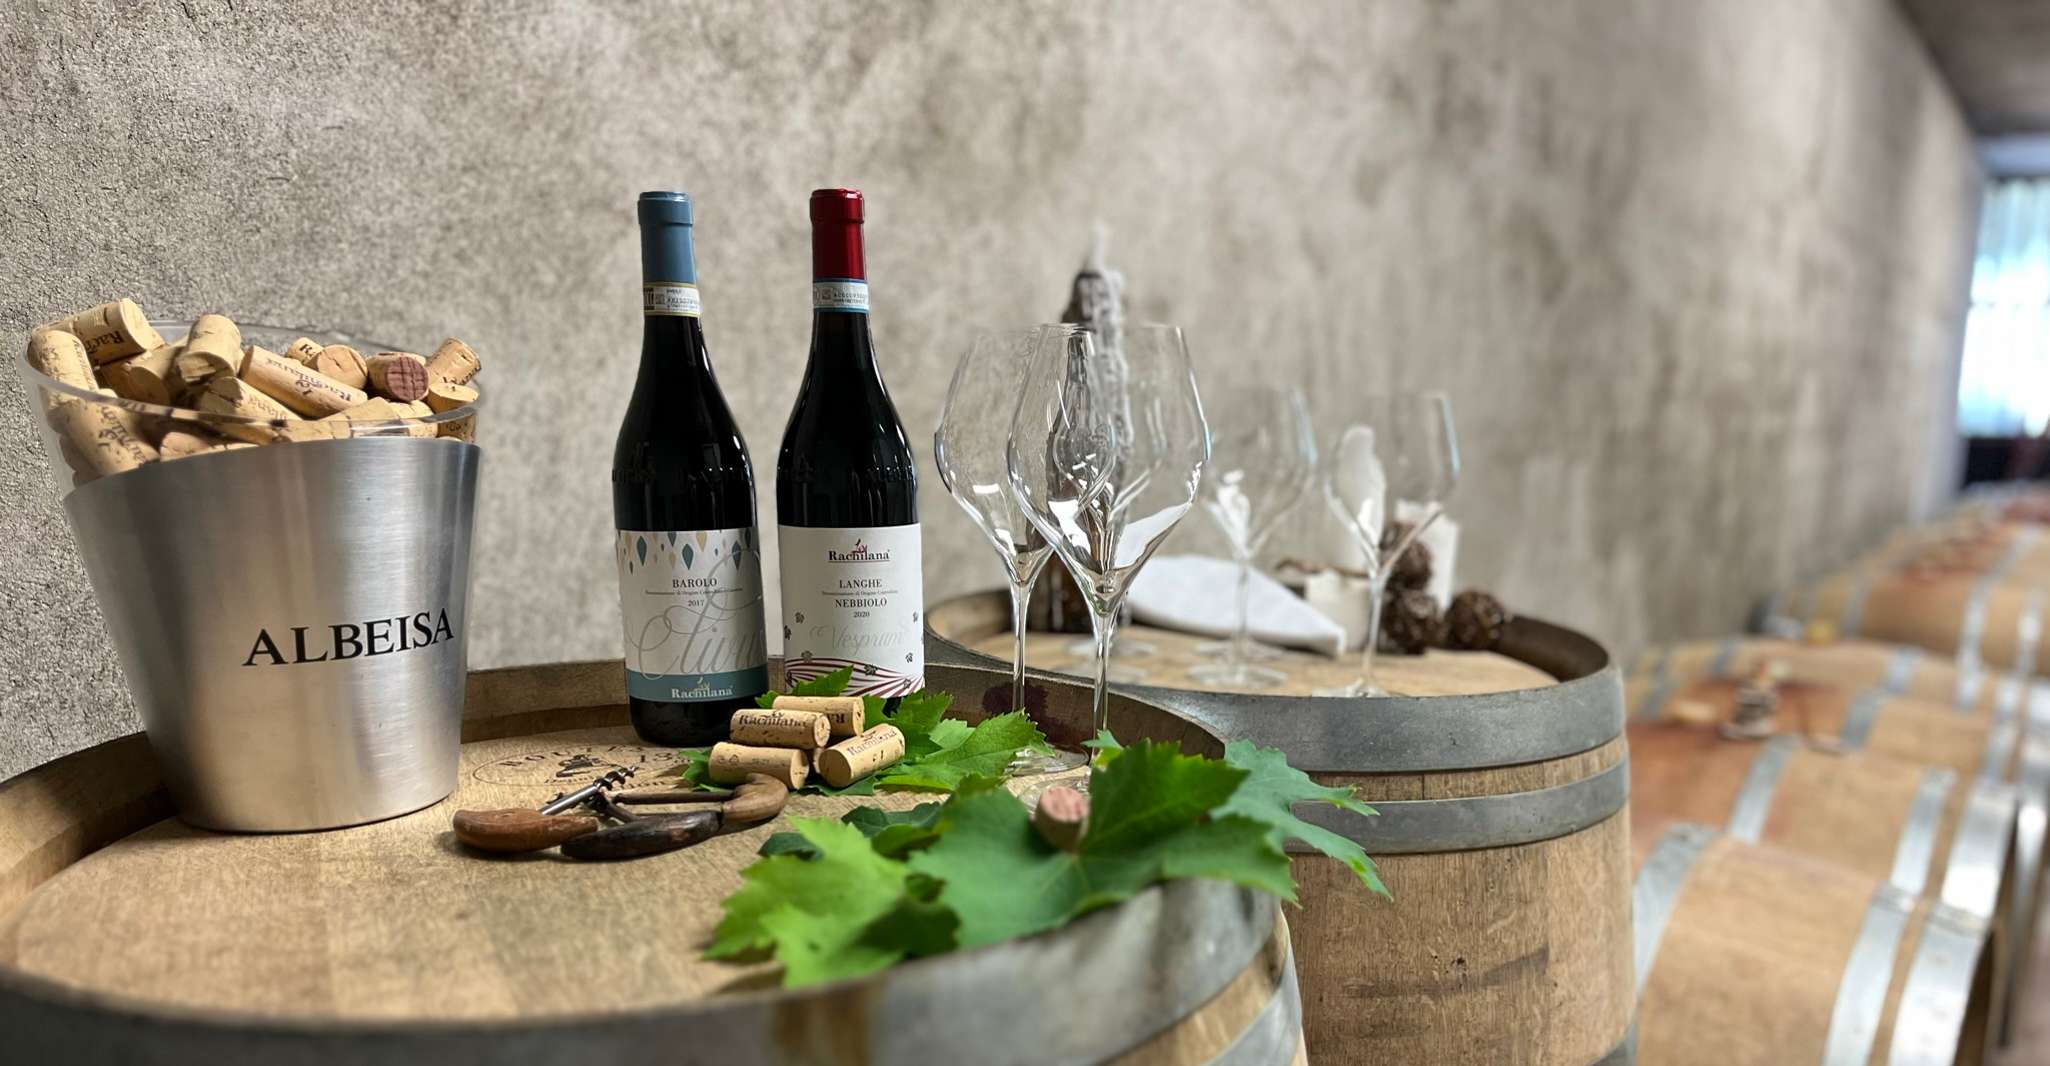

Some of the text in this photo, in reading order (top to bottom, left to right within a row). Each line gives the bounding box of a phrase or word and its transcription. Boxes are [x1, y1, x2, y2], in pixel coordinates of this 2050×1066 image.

[828, 550, 889, 561] Rachilana
[672, 578, 718, 588] BAROLO
[839, 579, 882, 589] LANGHE
[835, 598, 888, 608] NEBBIOLO
[241, 608, 454, 666] ALBEISA
[671, 687, 731, 699] Rachilana
